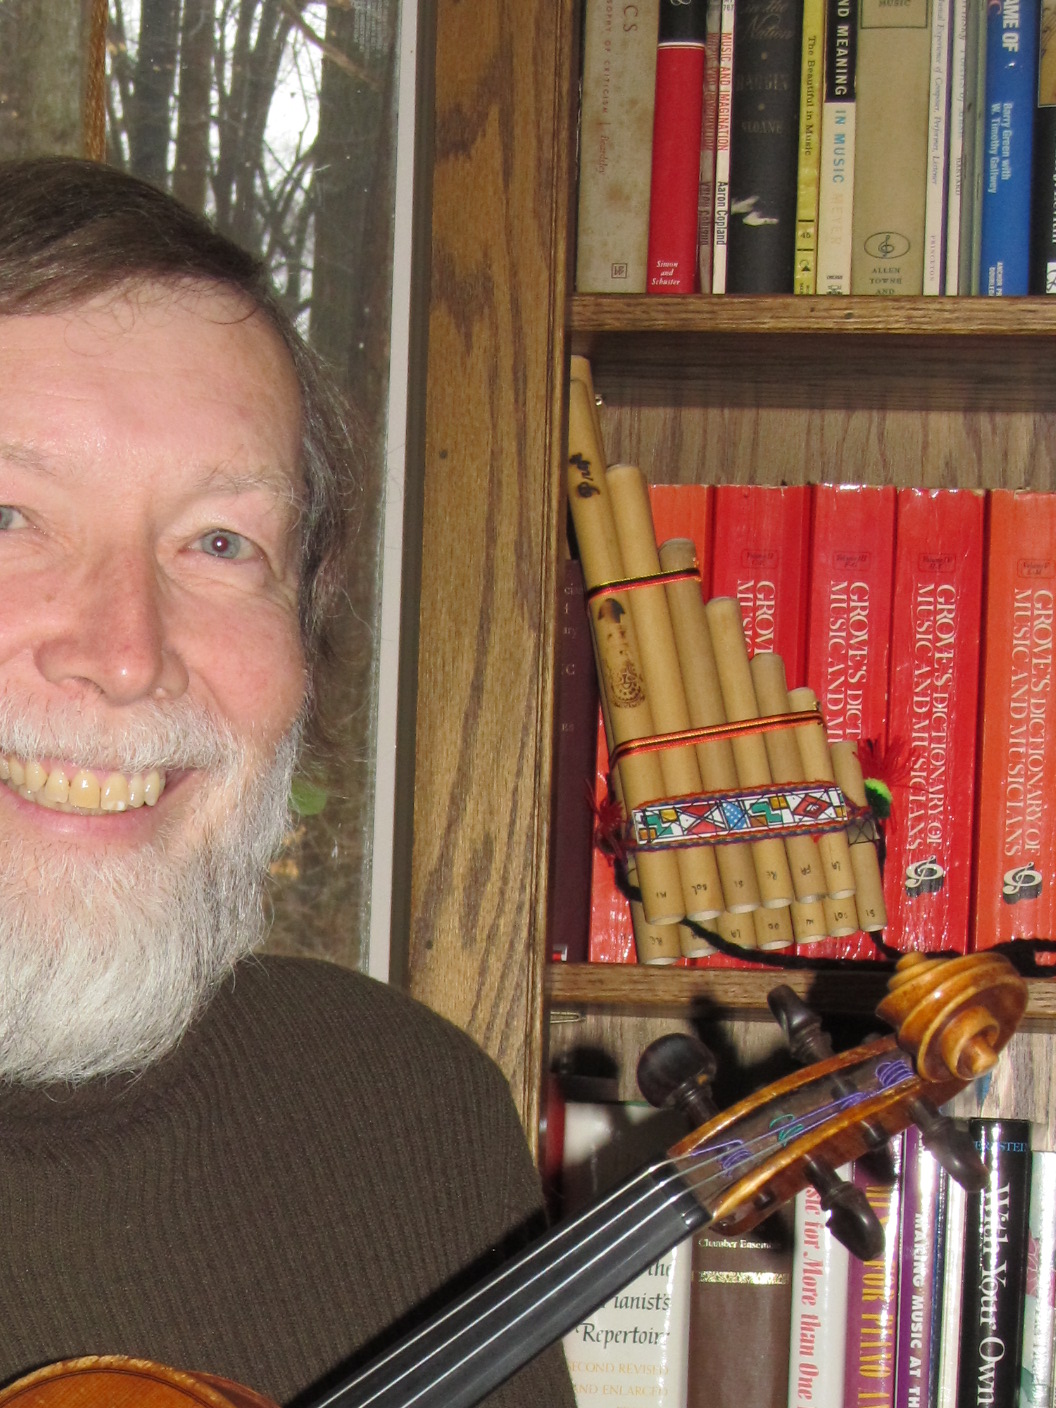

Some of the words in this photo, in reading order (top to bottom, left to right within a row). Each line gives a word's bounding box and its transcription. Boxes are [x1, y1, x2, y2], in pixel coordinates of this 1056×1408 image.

[837, 0, 850, 17] ND
[1002, 0, 1021, 28] AME
[604, 40, 612, 52] OF
[720, 32, 733, 62] MUSIC
[808, 35, 817, 56] The
[834, 25, 849, 96] MEANING
[1002, 32, 1020, 52] OF
[602, 60, 611, 113] CRITICISM
[719, 66, 732, 87] AND
[806, 60, 816, 107] Beautiful
[717, 90, 731, 151] IMAGINATION
[806, 110, 813, 121] in
[834, 110, 846, 125] IN
[991, 103, 1002, 115] W.
[1001, 102, 1014, 126] Barry
[804, 124, 814, 156] Music
[989, 118, 1001, 155] Timothy
[1002, 130, 1013, 157] Green
[832, 133, 846, 184] MUSIC
[988, 157, 1000, 193] Gallwey
[1001, 160, 1012, 180] with
[717, 181, 729, 207] Aaron
[715, 209, 729, 246] Copland
[656, 260, 679, 268] Simon
[660, 269, 675, 277] and
[929, 235, 937, 281] PRINCETON
[651, 277, 681, 286] Schuster
[754, 580, 776, 654] GROV
[828, 579, 849, 653] MUSIC
[847, 581, 870, 684] GROVE'S
[914, 583, 935, 656] MUSIC
[1011, 588, 1032, 663] MUSIC
[933, 584, 957, 688] GROVE'S
[1030, 589, 1054, 692] GROVE'S
[826, 657, 846, 711] AND
[912, 660, 932, 713] AND
[1009, 667, 1029, 719] AND
[845, 689, 863, 740] DICT
[927, 693, 949, 816] DICTIONARY
[1025, 698, 1047, 822] DICTIONARY
[907, 718, 930, 850] MUSICIANS
[1004, 725, 1028, 856] MUSICIANS
[926, 822, 943, 850] OF
[1024, 829, 1041, 857] OF
[699, 1239, 737, 1249] Chamber
[803, 1221, 825, 1250] for
[801, 1251, 824, 1307] More
[979, 1259, 1007, 1331] Your
[614, 1293, 672, 1311] ianist's
[799, 1313, 822, 1357] than
[910, 1294, 924, 1349] MUSIC
[858, 1313, 894, 1379] PIANO
[618, 1362, 670, 1376] REVISED
[797, 1363, 820, 1400] One
[908, 1356, 923, 1378] AT
[977, 1336, 1005, 1406] Own
[602, 1385, 669, 1397] ENLARGED
